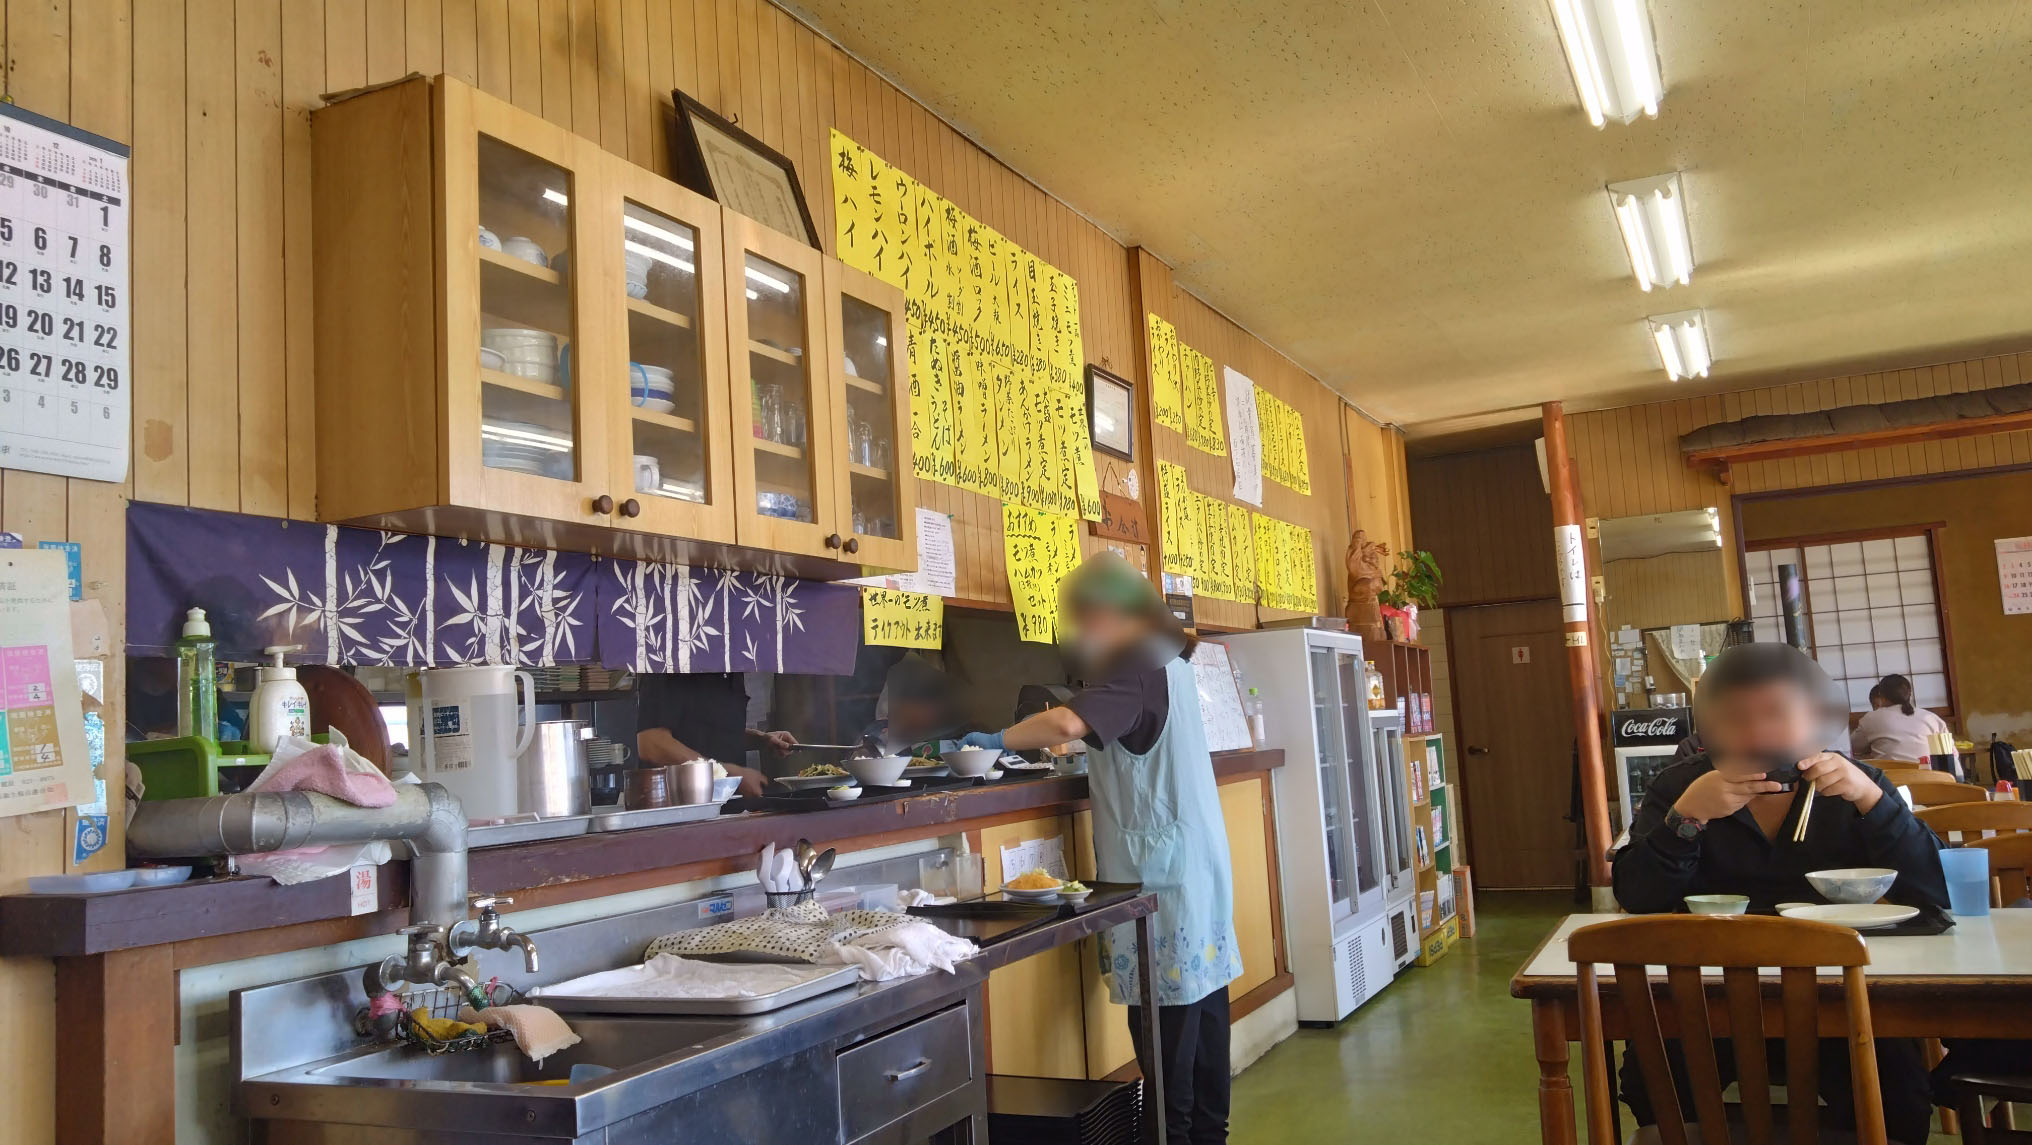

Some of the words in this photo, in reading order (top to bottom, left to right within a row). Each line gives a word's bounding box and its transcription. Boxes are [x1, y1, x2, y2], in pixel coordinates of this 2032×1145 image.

[33, 183, 48, 199] 30
[66, 193, 79, 209] 31
[99, 205, 109, 228] 1
[868, 159, 889, 273] レモンハイ
[0, 216, 13, 242] 5
[34, 226, 47, 251] 6
[68, 235, 79, 259] 7
[99, 244, 112, 268] 8
[895, 175, 913, 291] ウーロンハイ
[920, 196, 940, 299] ハイボール
[28, 268, 52, 294] 13
[62, 276, 85, 302] 14
[94, 284, 117, 309] 15
[1010, 251, 1024, 321] ライス
[26, 309, 54, 337] 20
[62, 317, 85, 344] 21
[93, 324, 118, 350] 22
[0, 345, 20, 372] 26
[29, 352, 53, 379] 27
[61, 358, 87, 385] 28
[93, 364, 119, 391] 29
[2, 389, 11, 403] 3
[38, 395, 46, 409] 4
[70, 400, 79, 415] 5
[103, 406, 111, 420] 6
[1621, 716, 1679, 737] Coca-Cola
[356, 869, 372, 890] 湯
